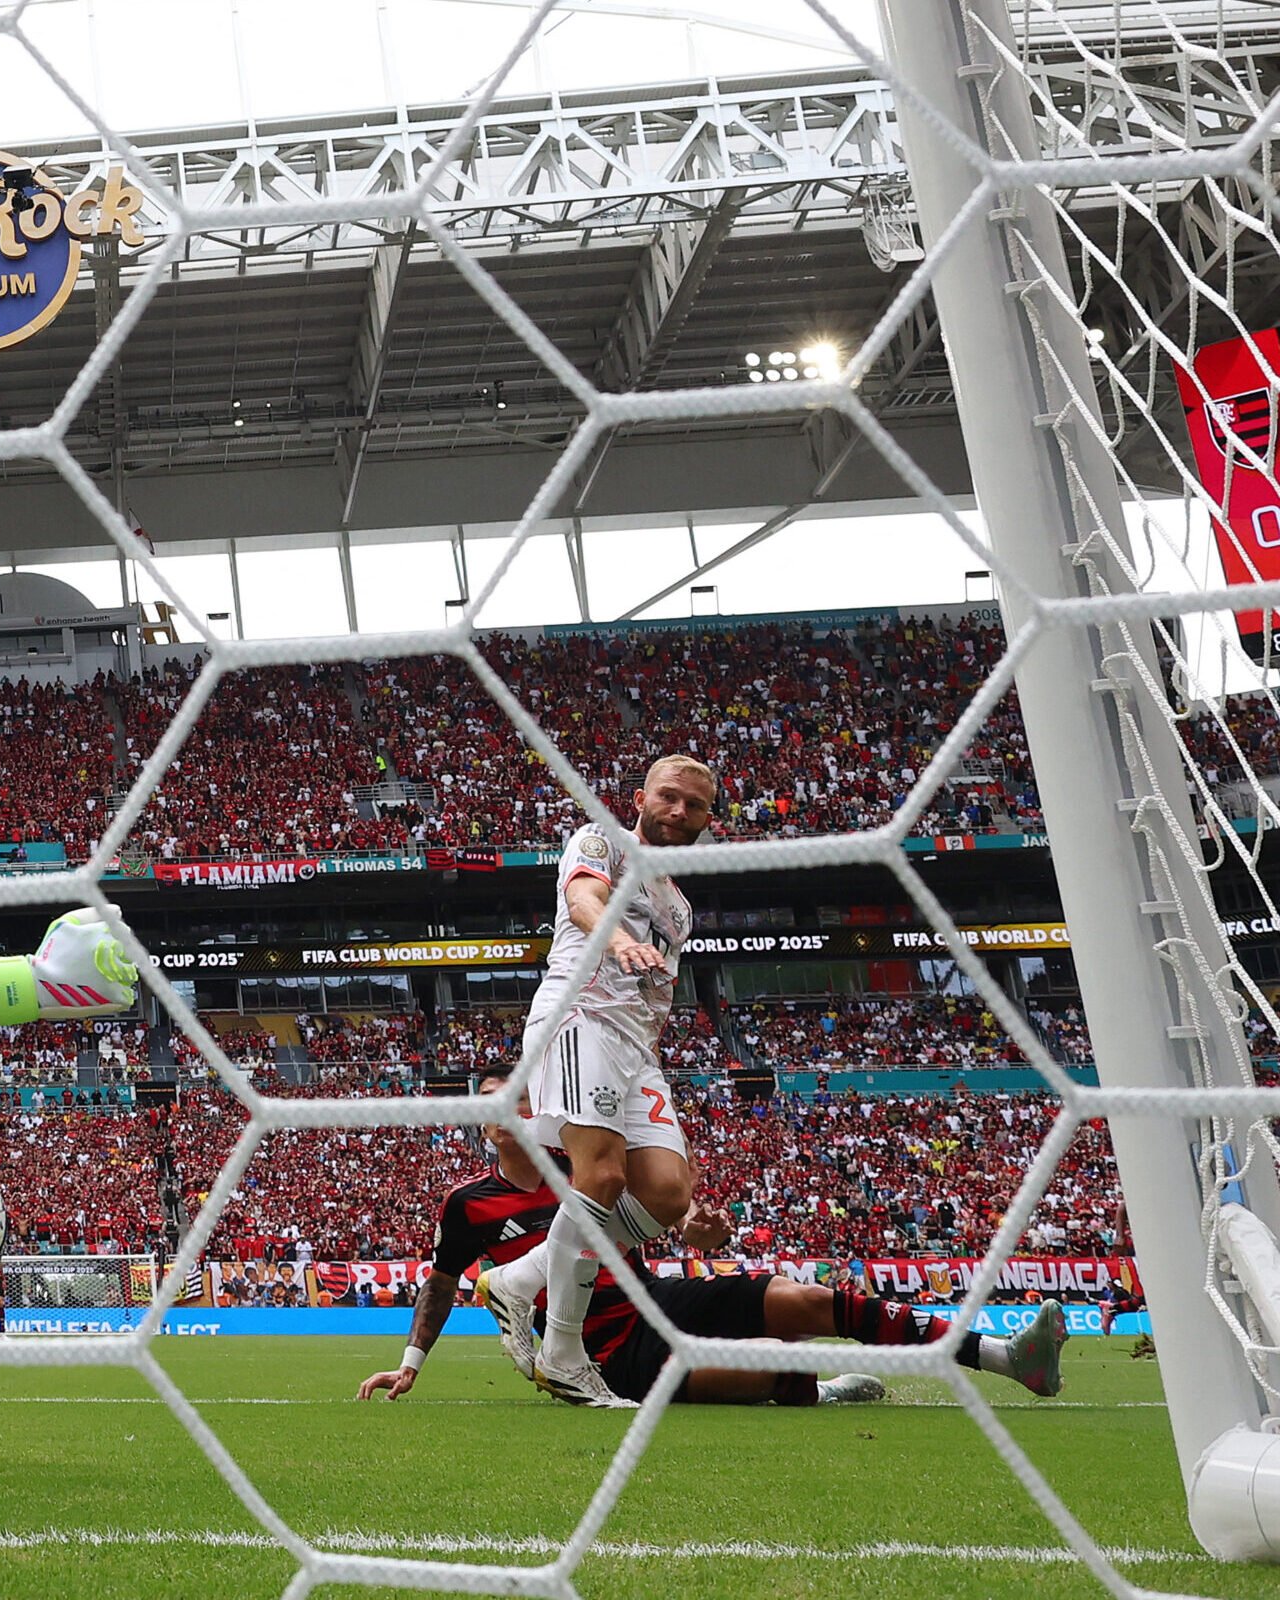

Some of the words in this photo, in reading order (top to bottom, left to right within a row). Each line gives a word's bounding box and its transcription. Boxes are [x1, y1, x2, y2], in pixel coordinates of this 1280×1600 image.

[46, 617, 82, 626] enhance
[83, 614, 111, 623] health
[971, 607, 1001, 621] 308
[333, 859, 396, 872] THOMAS
[401, 857, 423, 871] 54
[179, 863, 296, 886] FLAMIAMI
[1222, 921, 1250, 937] IFA
[741, 937, 776, 951] CUP
[893, 932, 932, 947] FIFA
[933, 931, 979, 945] CUB
[980, 929, 1048, 945] WORLD
[1050, 929, 1071, 942] CU
[163, 954, 195, 967] CUP
[302, 950, 337, 964] FIFA
[339, 948, 381, 963] CLUB
[384, 946, 444, 962] WORLD
[446, 945, 479, 960] CUP
[34, 1266, 60, 1274] WORLD
[61, 1266, 76, 1274] CUP
[872, 1263, 923, 1293] FLA
[4, 1319, 62, 1333] WITH
